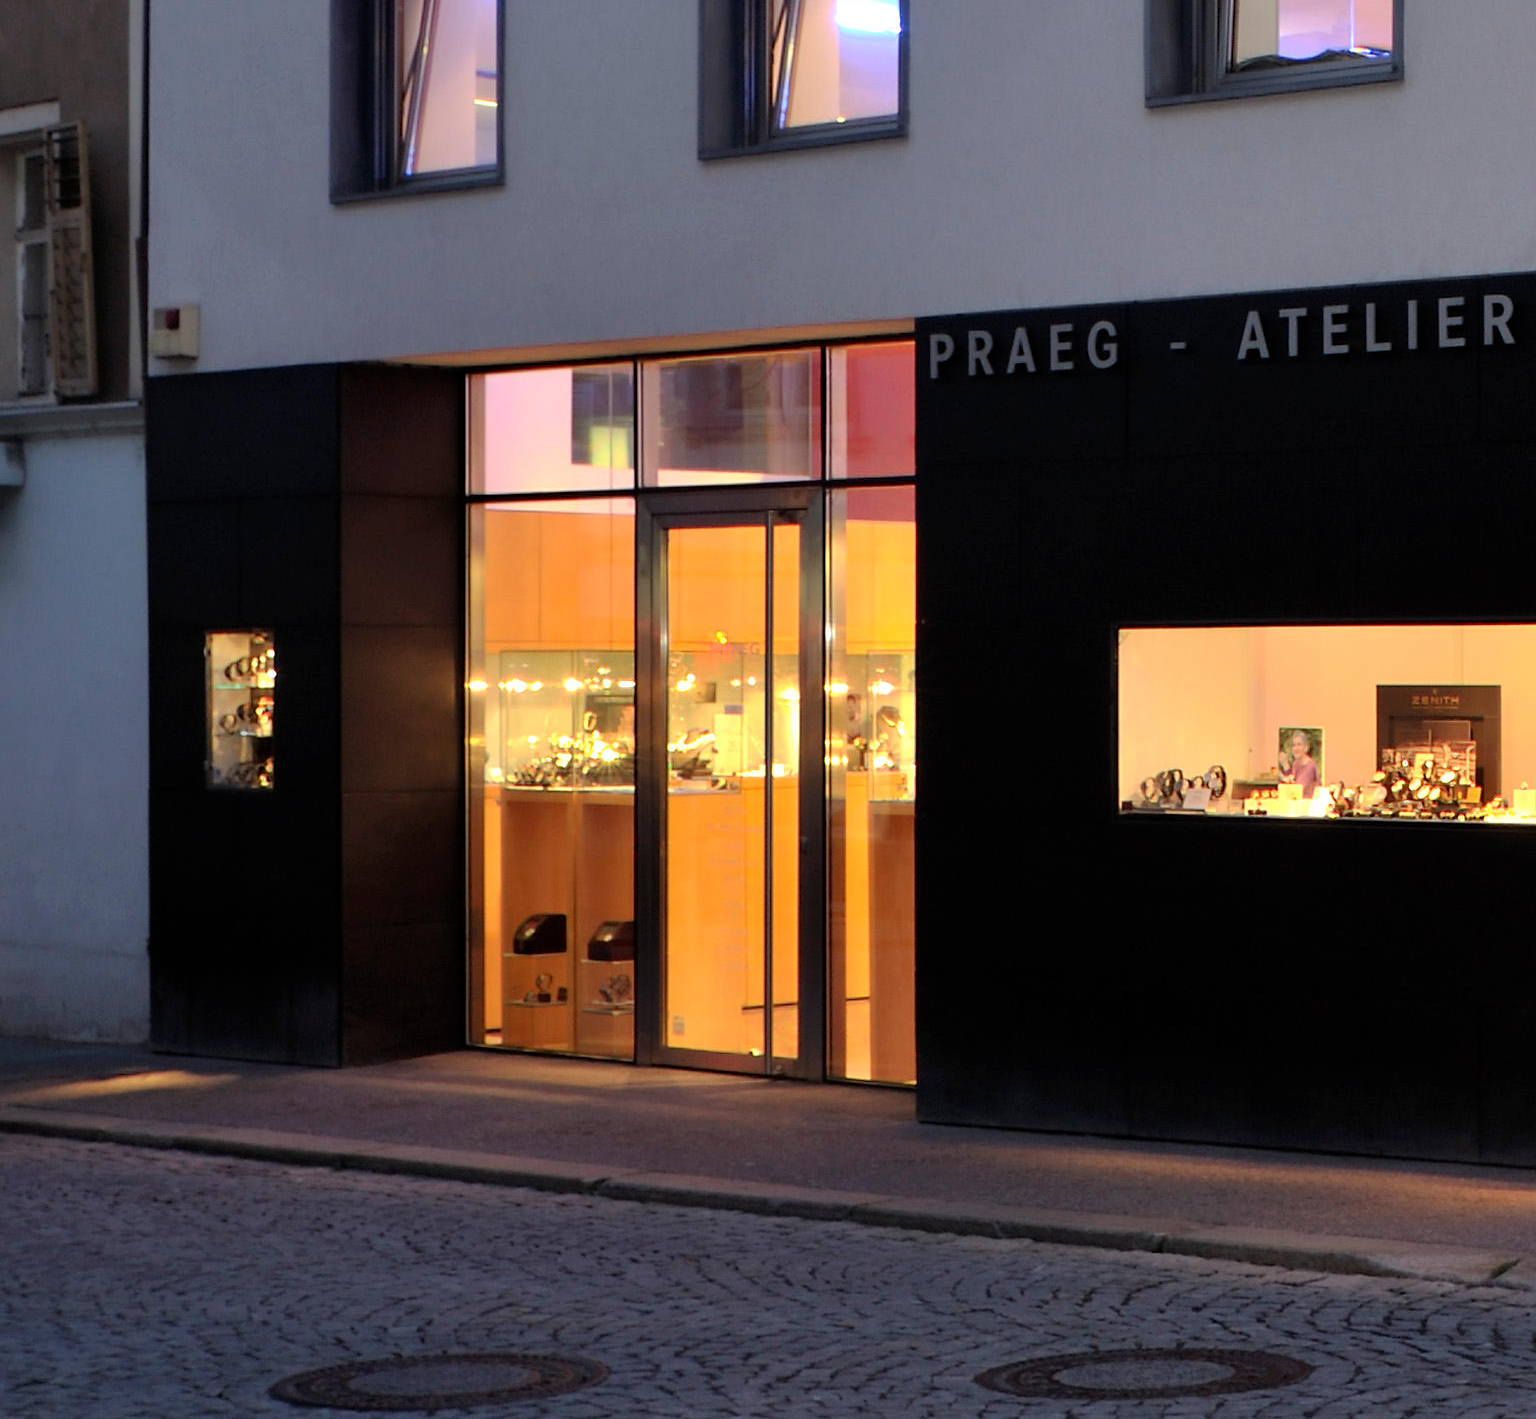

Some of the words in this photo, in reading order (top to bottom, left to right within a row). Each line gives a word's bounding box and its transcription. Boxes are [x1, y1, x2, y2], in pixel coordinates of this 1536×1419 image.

[928, 320, 1119, 380] PRAEG
[1236, 293, 1518, 361] ATELIER
[1411, 694, 1460, 706] ZENITH
